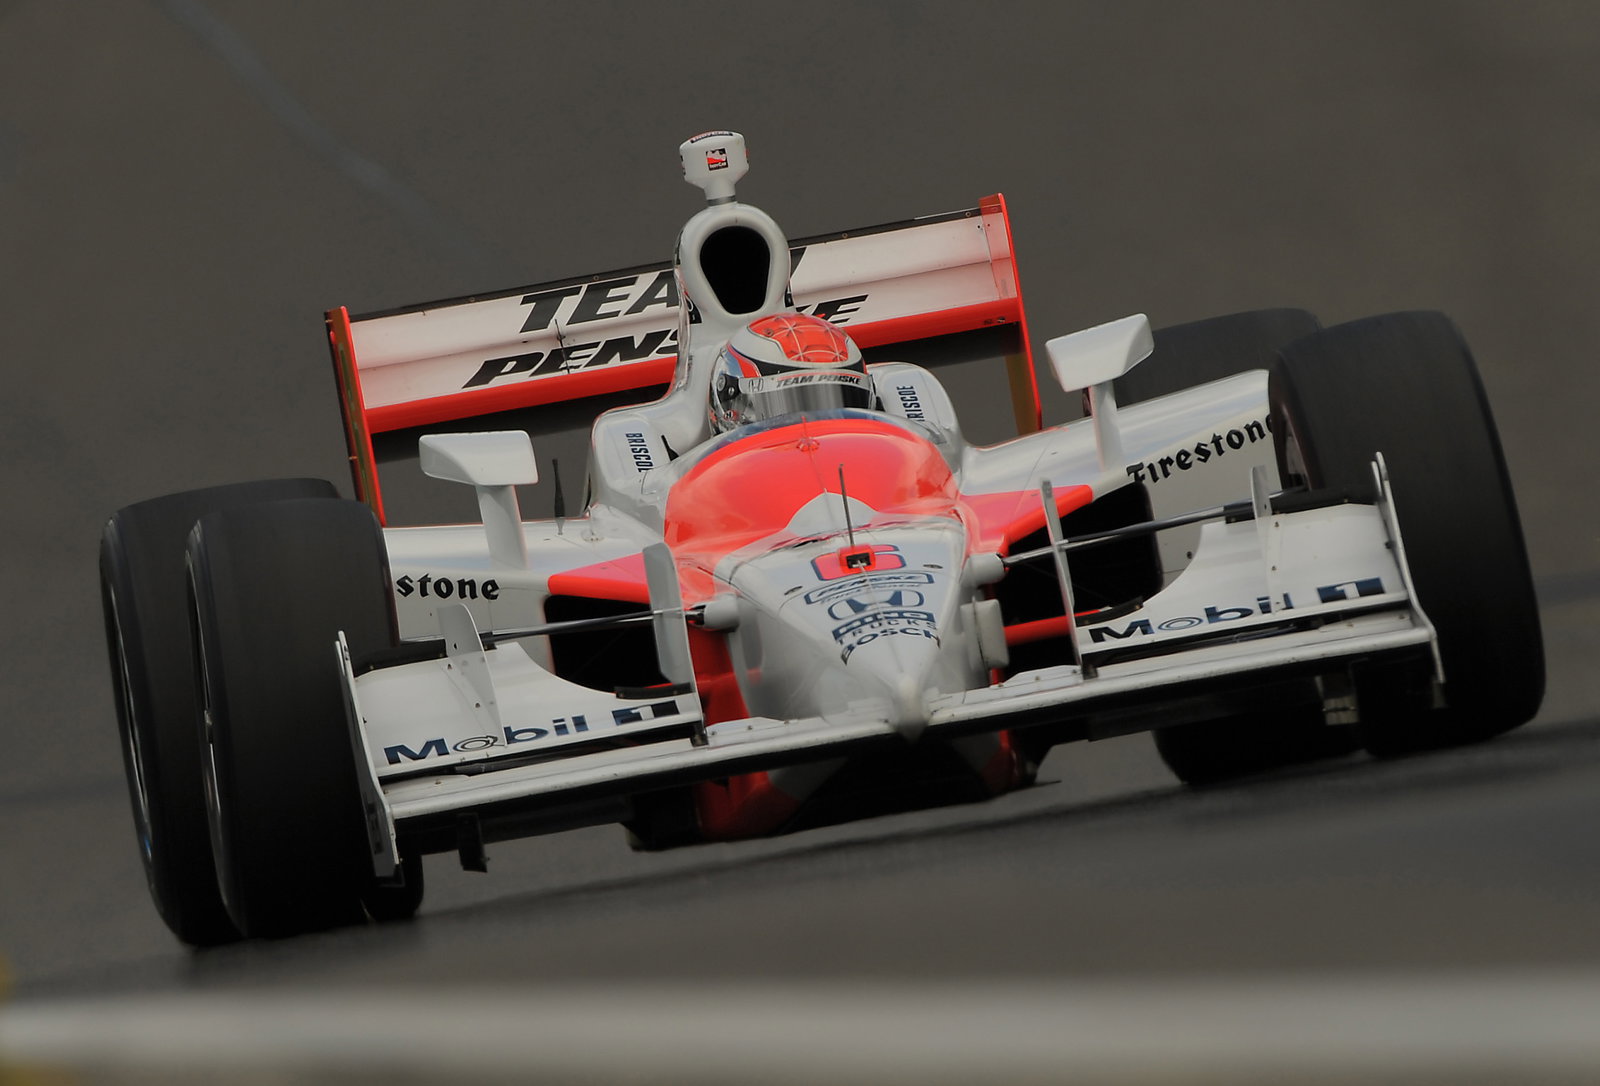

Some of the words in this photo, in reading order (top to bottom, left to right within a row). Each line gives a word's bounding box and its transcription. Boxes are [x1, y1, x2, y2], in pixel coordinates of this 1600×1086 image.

[777, 376, 814, 388] TEAM
[819, 375, 860, 385] PENSKE
[896, 386, 925, 422] RISCOE
[838, 620, 936, 645] TRUCKS
[1089, 592, 1294, 643] Mobil
[841, 628, 940, 665] BOSCH
[383, 714, 589, 765] Mobil
